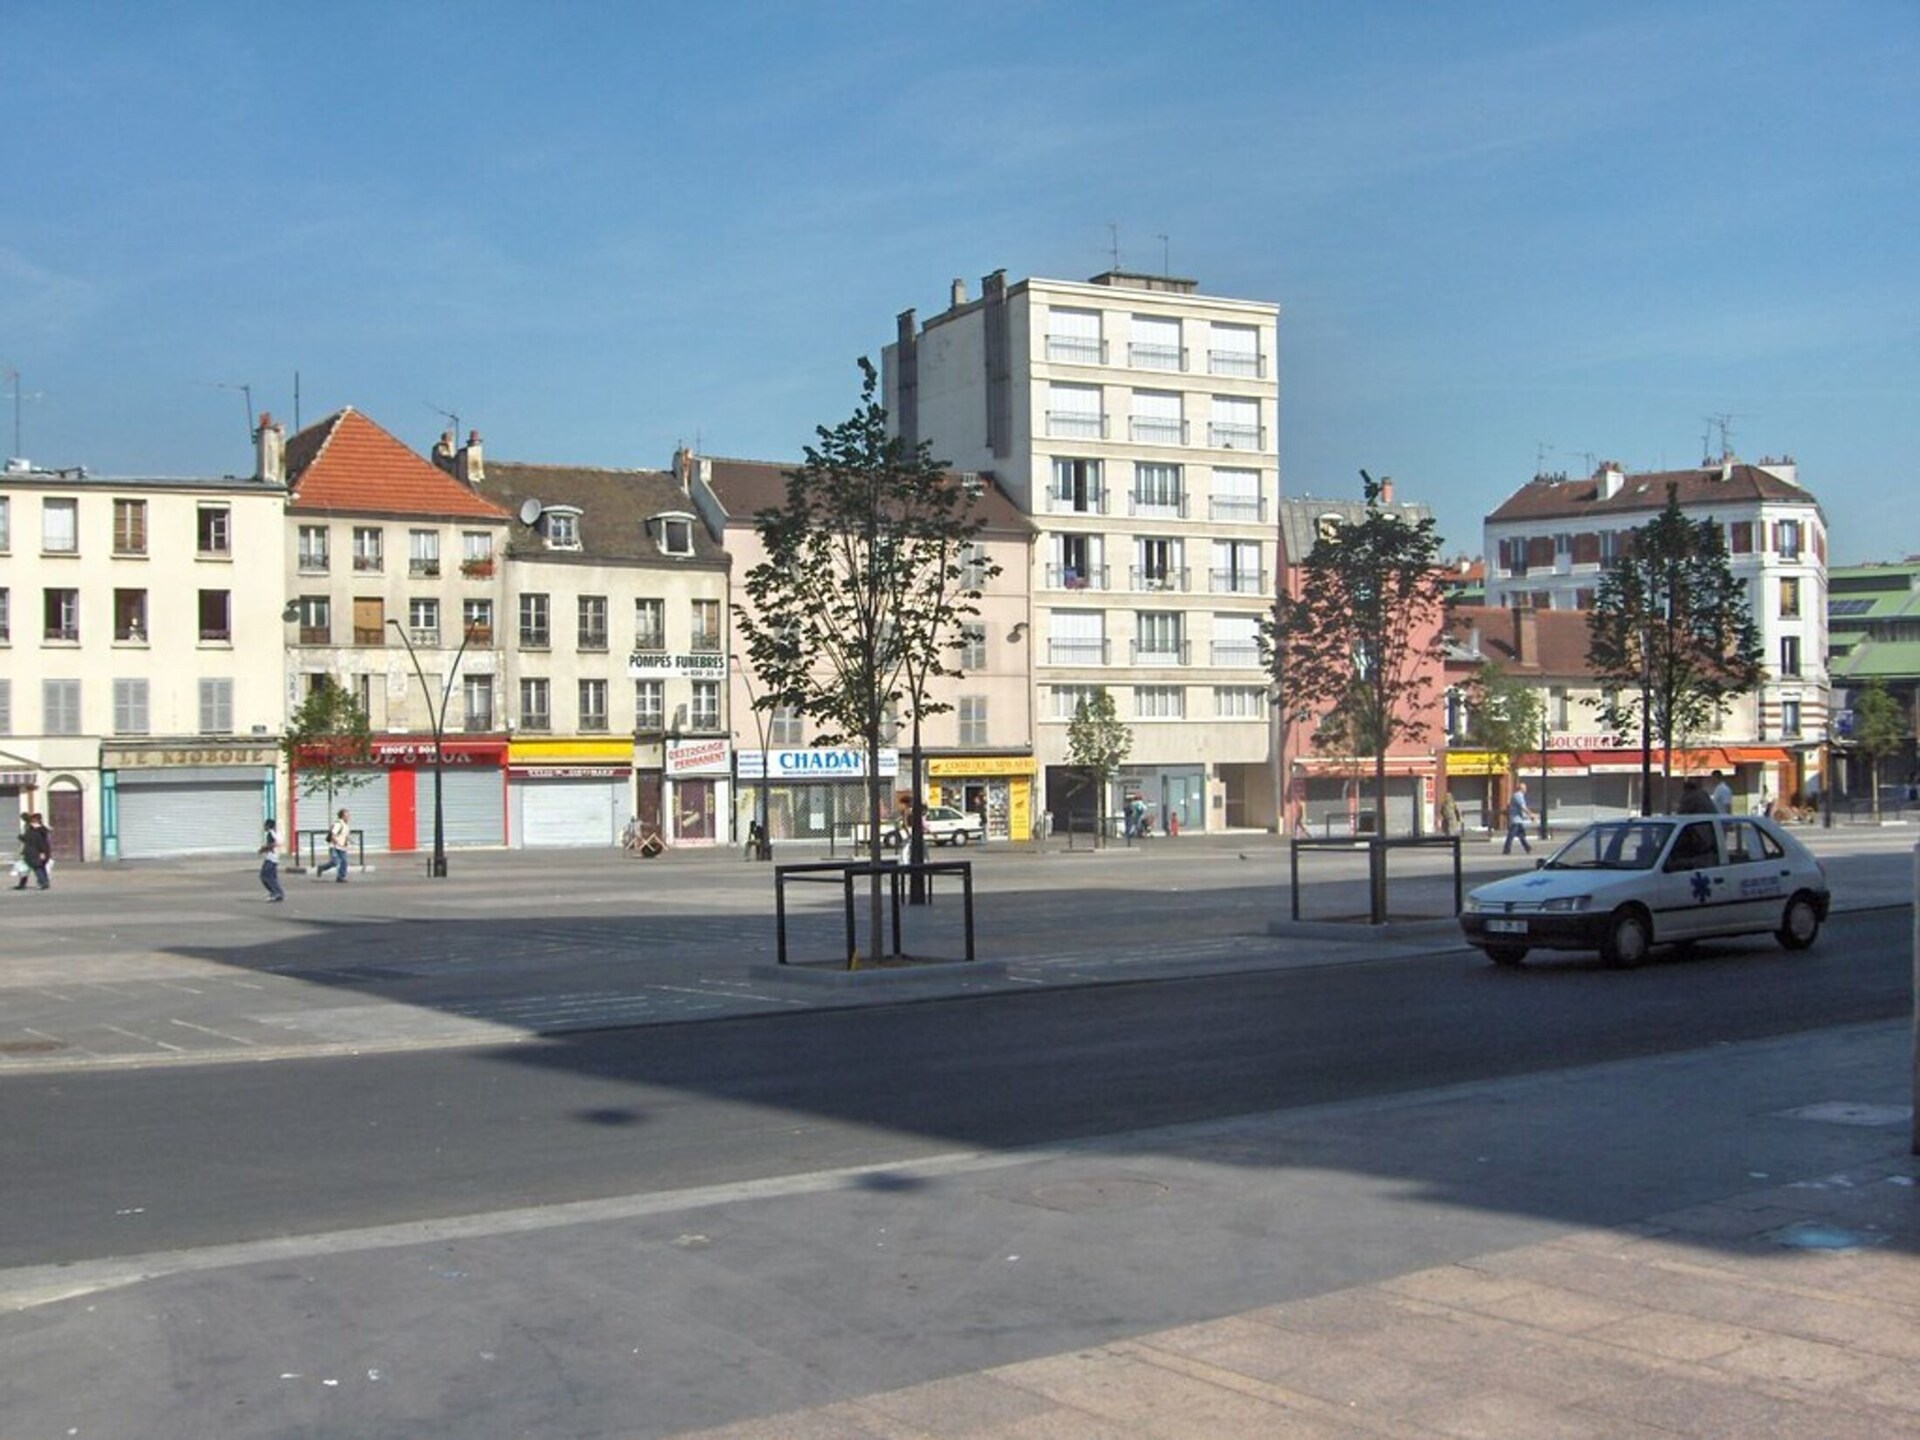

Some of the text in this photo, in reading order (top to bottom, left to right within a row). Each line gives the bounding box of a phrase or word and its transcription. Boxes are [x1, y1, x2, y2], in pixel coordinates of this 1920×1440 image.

[629, 655, 725, 668] POMPES FUNEBRES
[1548, 736, 1623, 748] BOUCHER
[120, 749, 263, 765] LE KIOSQUE
[674, 751, 726, 771] PERMANENT
